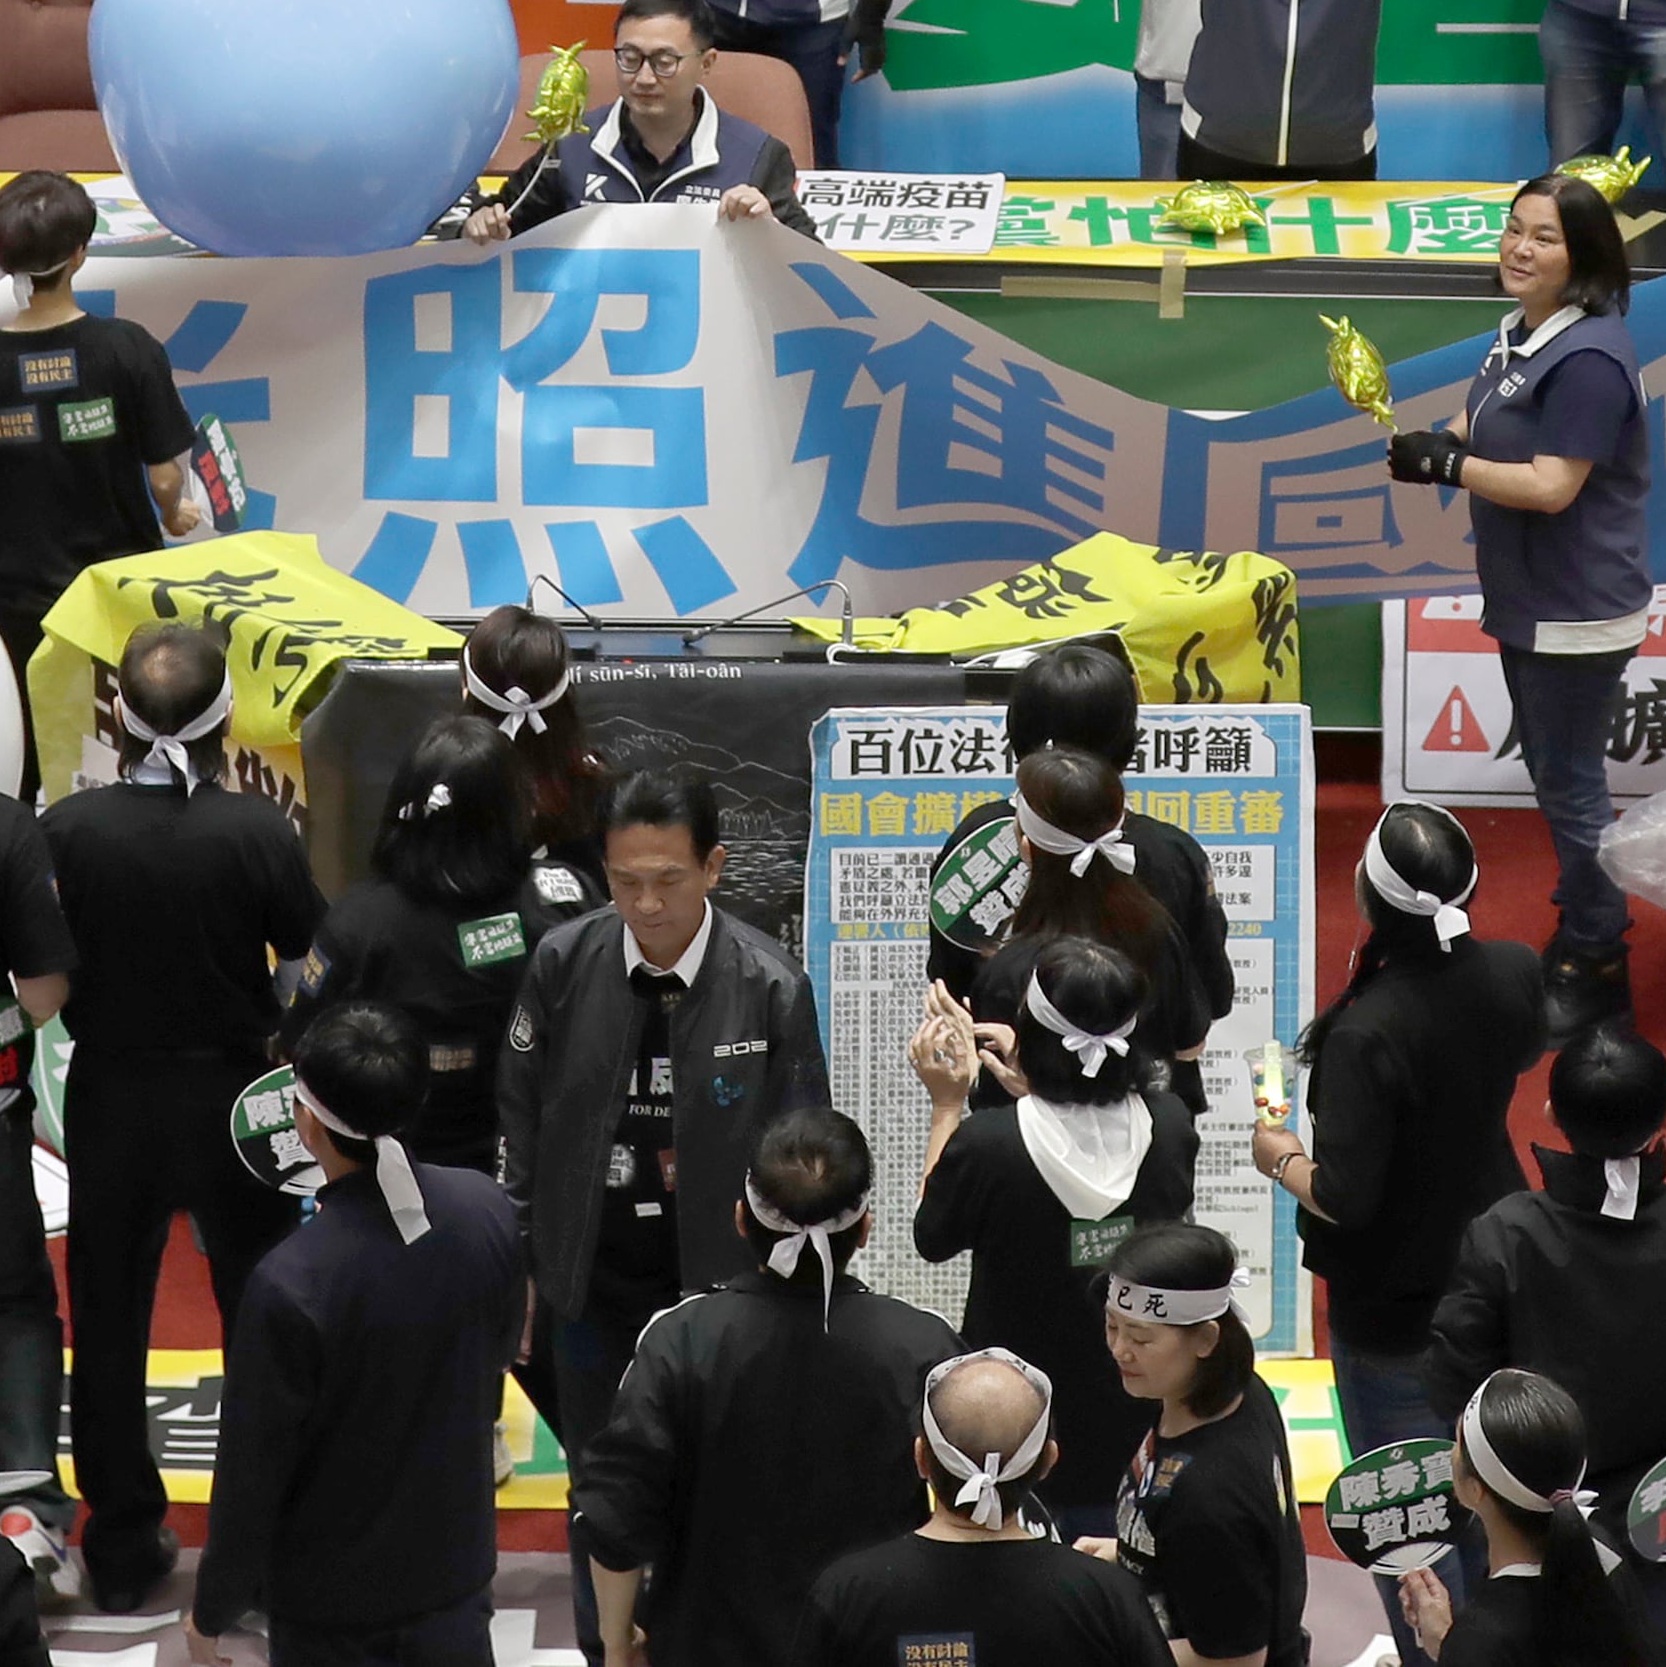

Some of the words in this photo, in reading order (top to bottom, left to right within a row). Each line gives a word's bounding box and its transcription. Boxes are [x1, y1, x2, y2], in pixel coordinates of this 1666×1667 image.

[800, 175, 994, 211] 高端疫苗
[817, 213, 978, 243] 什麼?
[1361, 1494, 1452, 1551] 贊成
